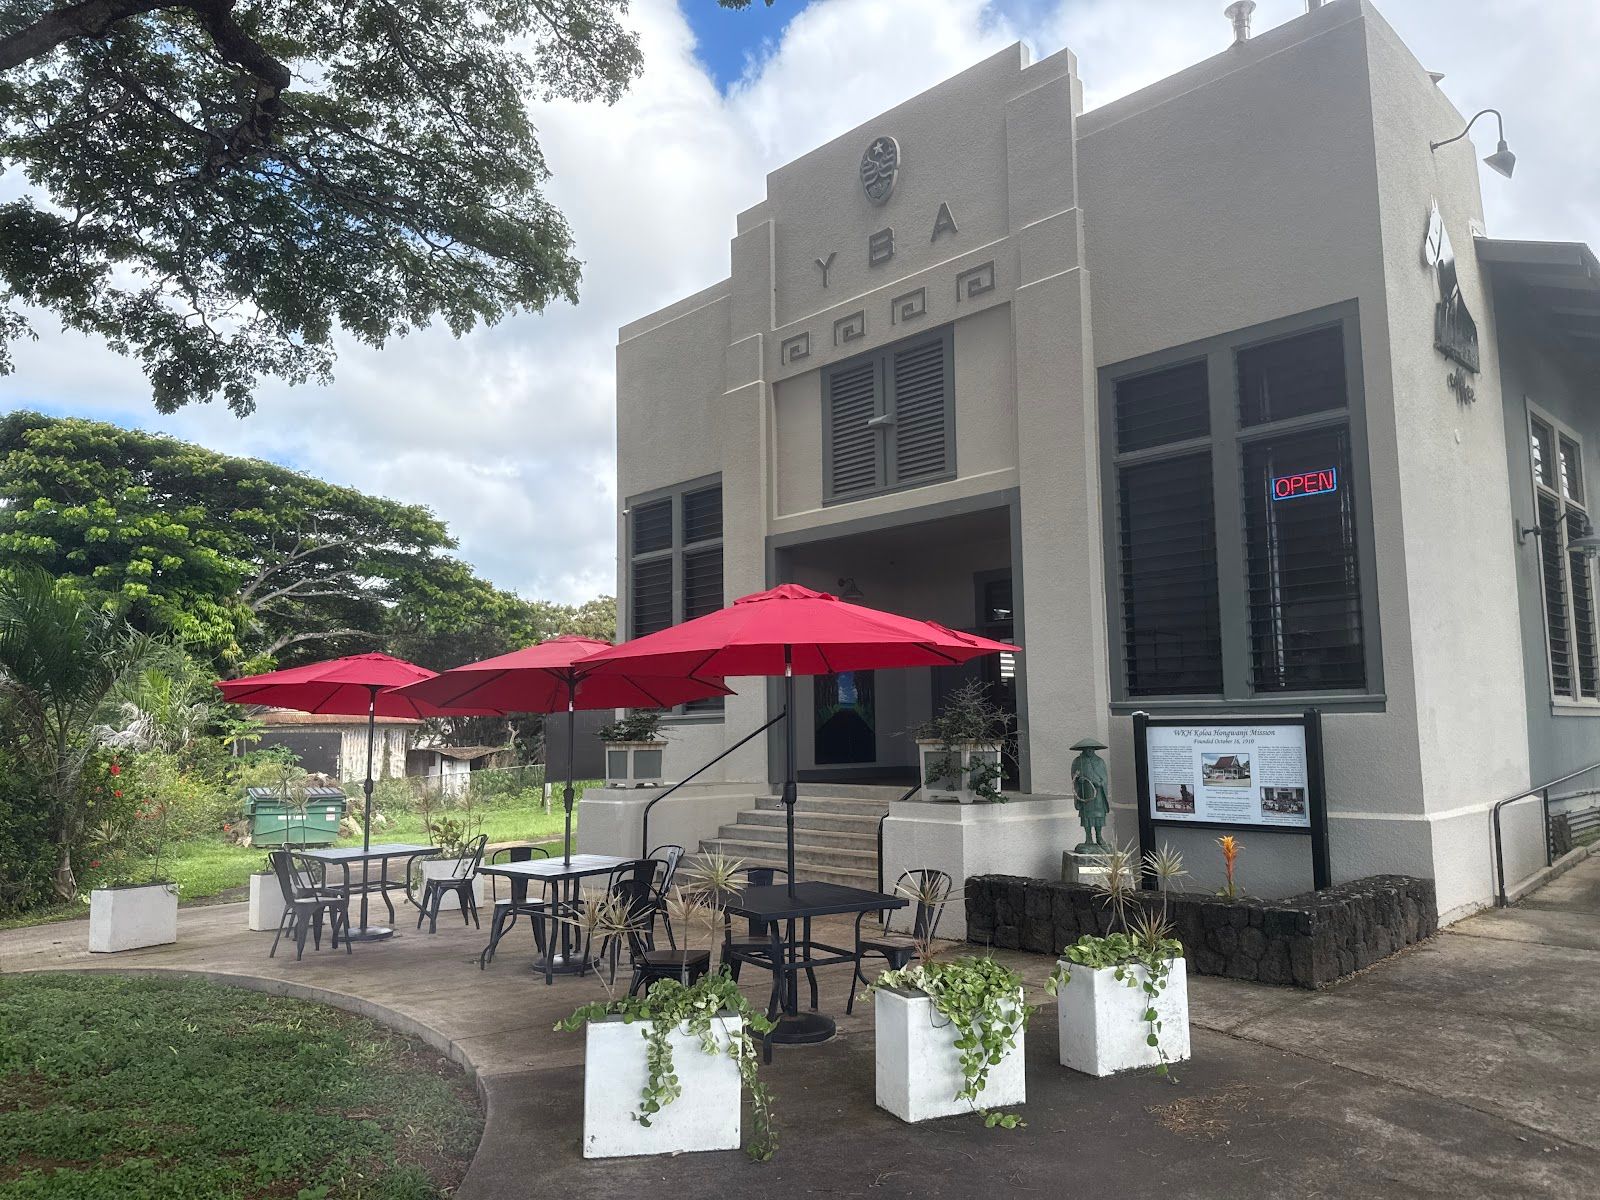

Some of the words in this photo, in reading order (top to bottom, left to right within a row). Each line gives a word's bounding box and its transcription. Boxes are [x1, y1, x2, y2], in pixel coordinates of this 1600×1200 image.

[1276, 470, 1333, 497] OPEN
[1174, 729, 1193, 737] WKH
[1194, 728, 1212, 737] Koloa
[1213, 729, 1248, 738] Hongwanji
